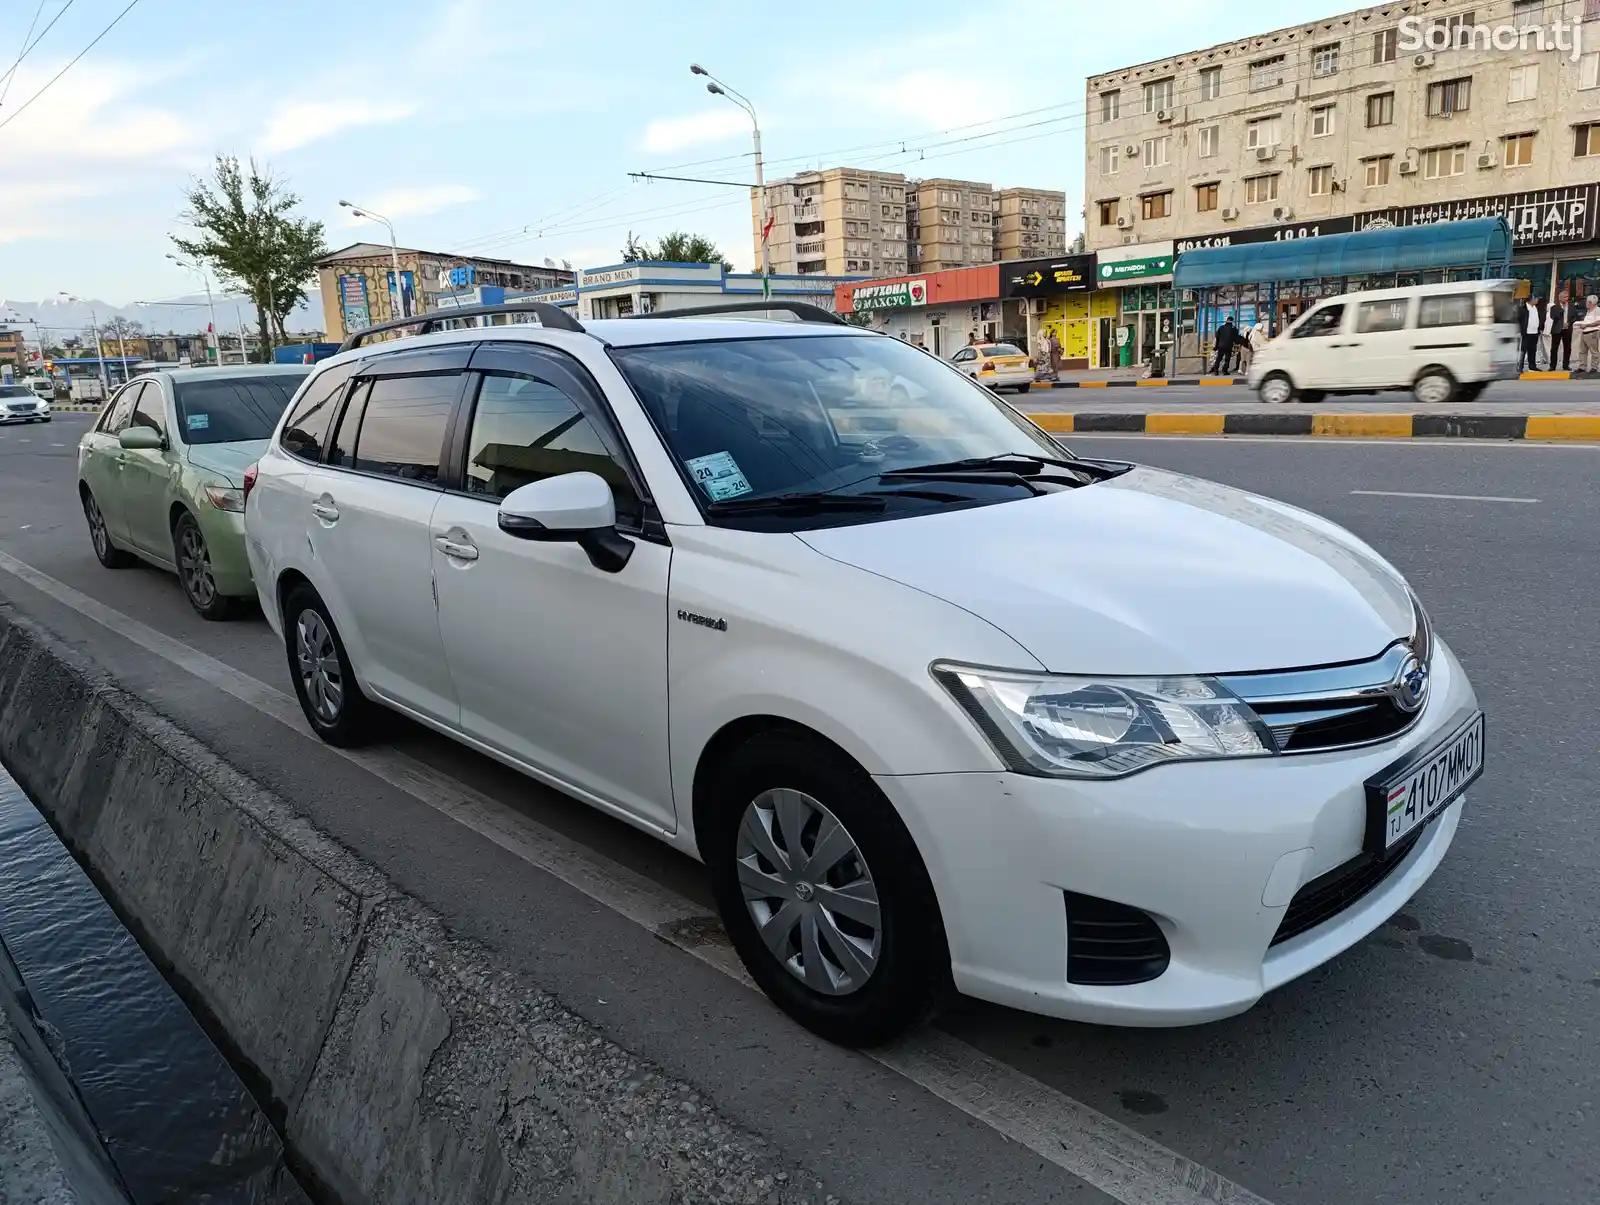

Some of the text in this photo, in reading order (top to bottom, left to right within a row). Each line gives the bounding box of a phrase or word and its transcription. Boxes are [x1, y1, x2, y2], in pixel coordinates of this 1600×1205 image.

[1537, 226, 1584, 240] одежда
[583, 270, 633, 285] BRAND MEN
[863, 295, 906, 309] МАХСУС
[1390, 815, 1401, 837] TJ
